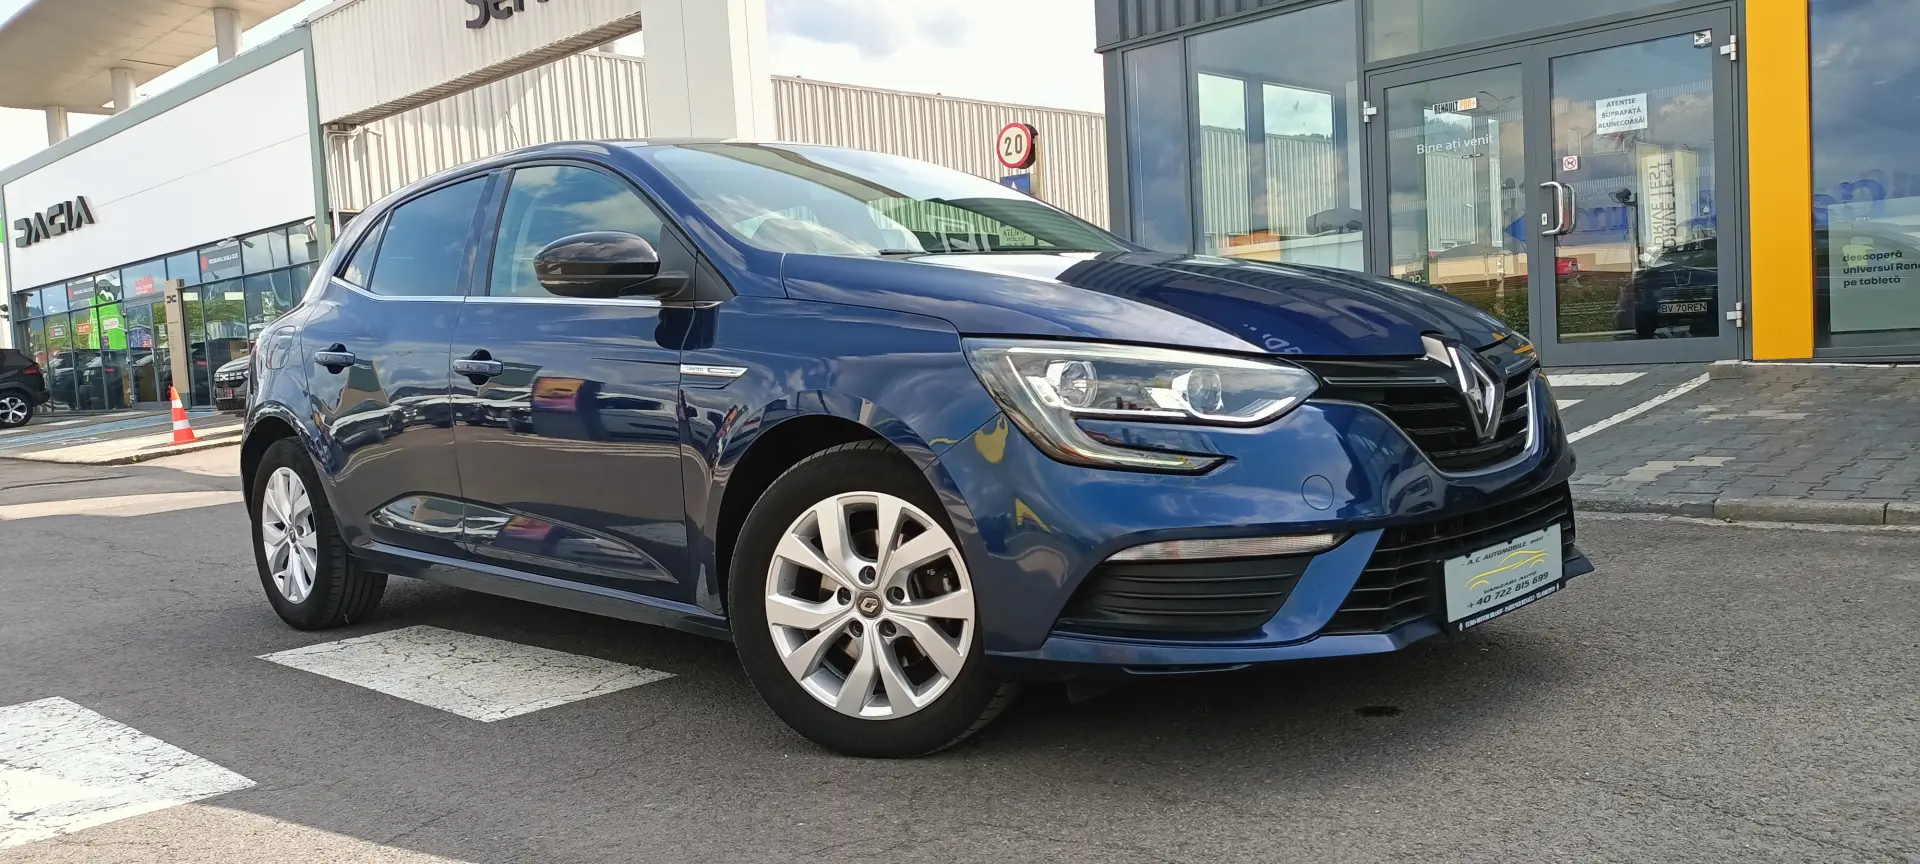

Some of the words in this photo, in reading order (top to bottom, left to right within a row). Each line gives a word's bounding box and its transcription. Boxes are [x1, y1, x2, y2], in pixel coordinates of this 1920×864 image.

[1434, 101, 1458, 114] RENAULT
[1004, 133, 1023, 156] 20
[1416, 143, 1442, 154] Bine
[1463, 133, 1494, 148] venit
[14, 195, 96, 248] DACIA
[1842, 249, 1903, 263] descoperă
[1843, 263, 1894, 275] universul
[1896, 261, 1920, 271] Ren
[1843, 280, 1857, 288] pe
[1859, 275, 1901, 286] tabletă
[1662, 304, 1674, 313] BV
[1483, 541, 1527, 560] AUTOMOBILE
[1518, 571, 1537, 582] AUTO
[1467, 594, 1491, 609] +40
[1494, 587, 1512, 600] 722
[1514, 580, 1530, 592] 815
[1532, 571, 1549, 584] 699
